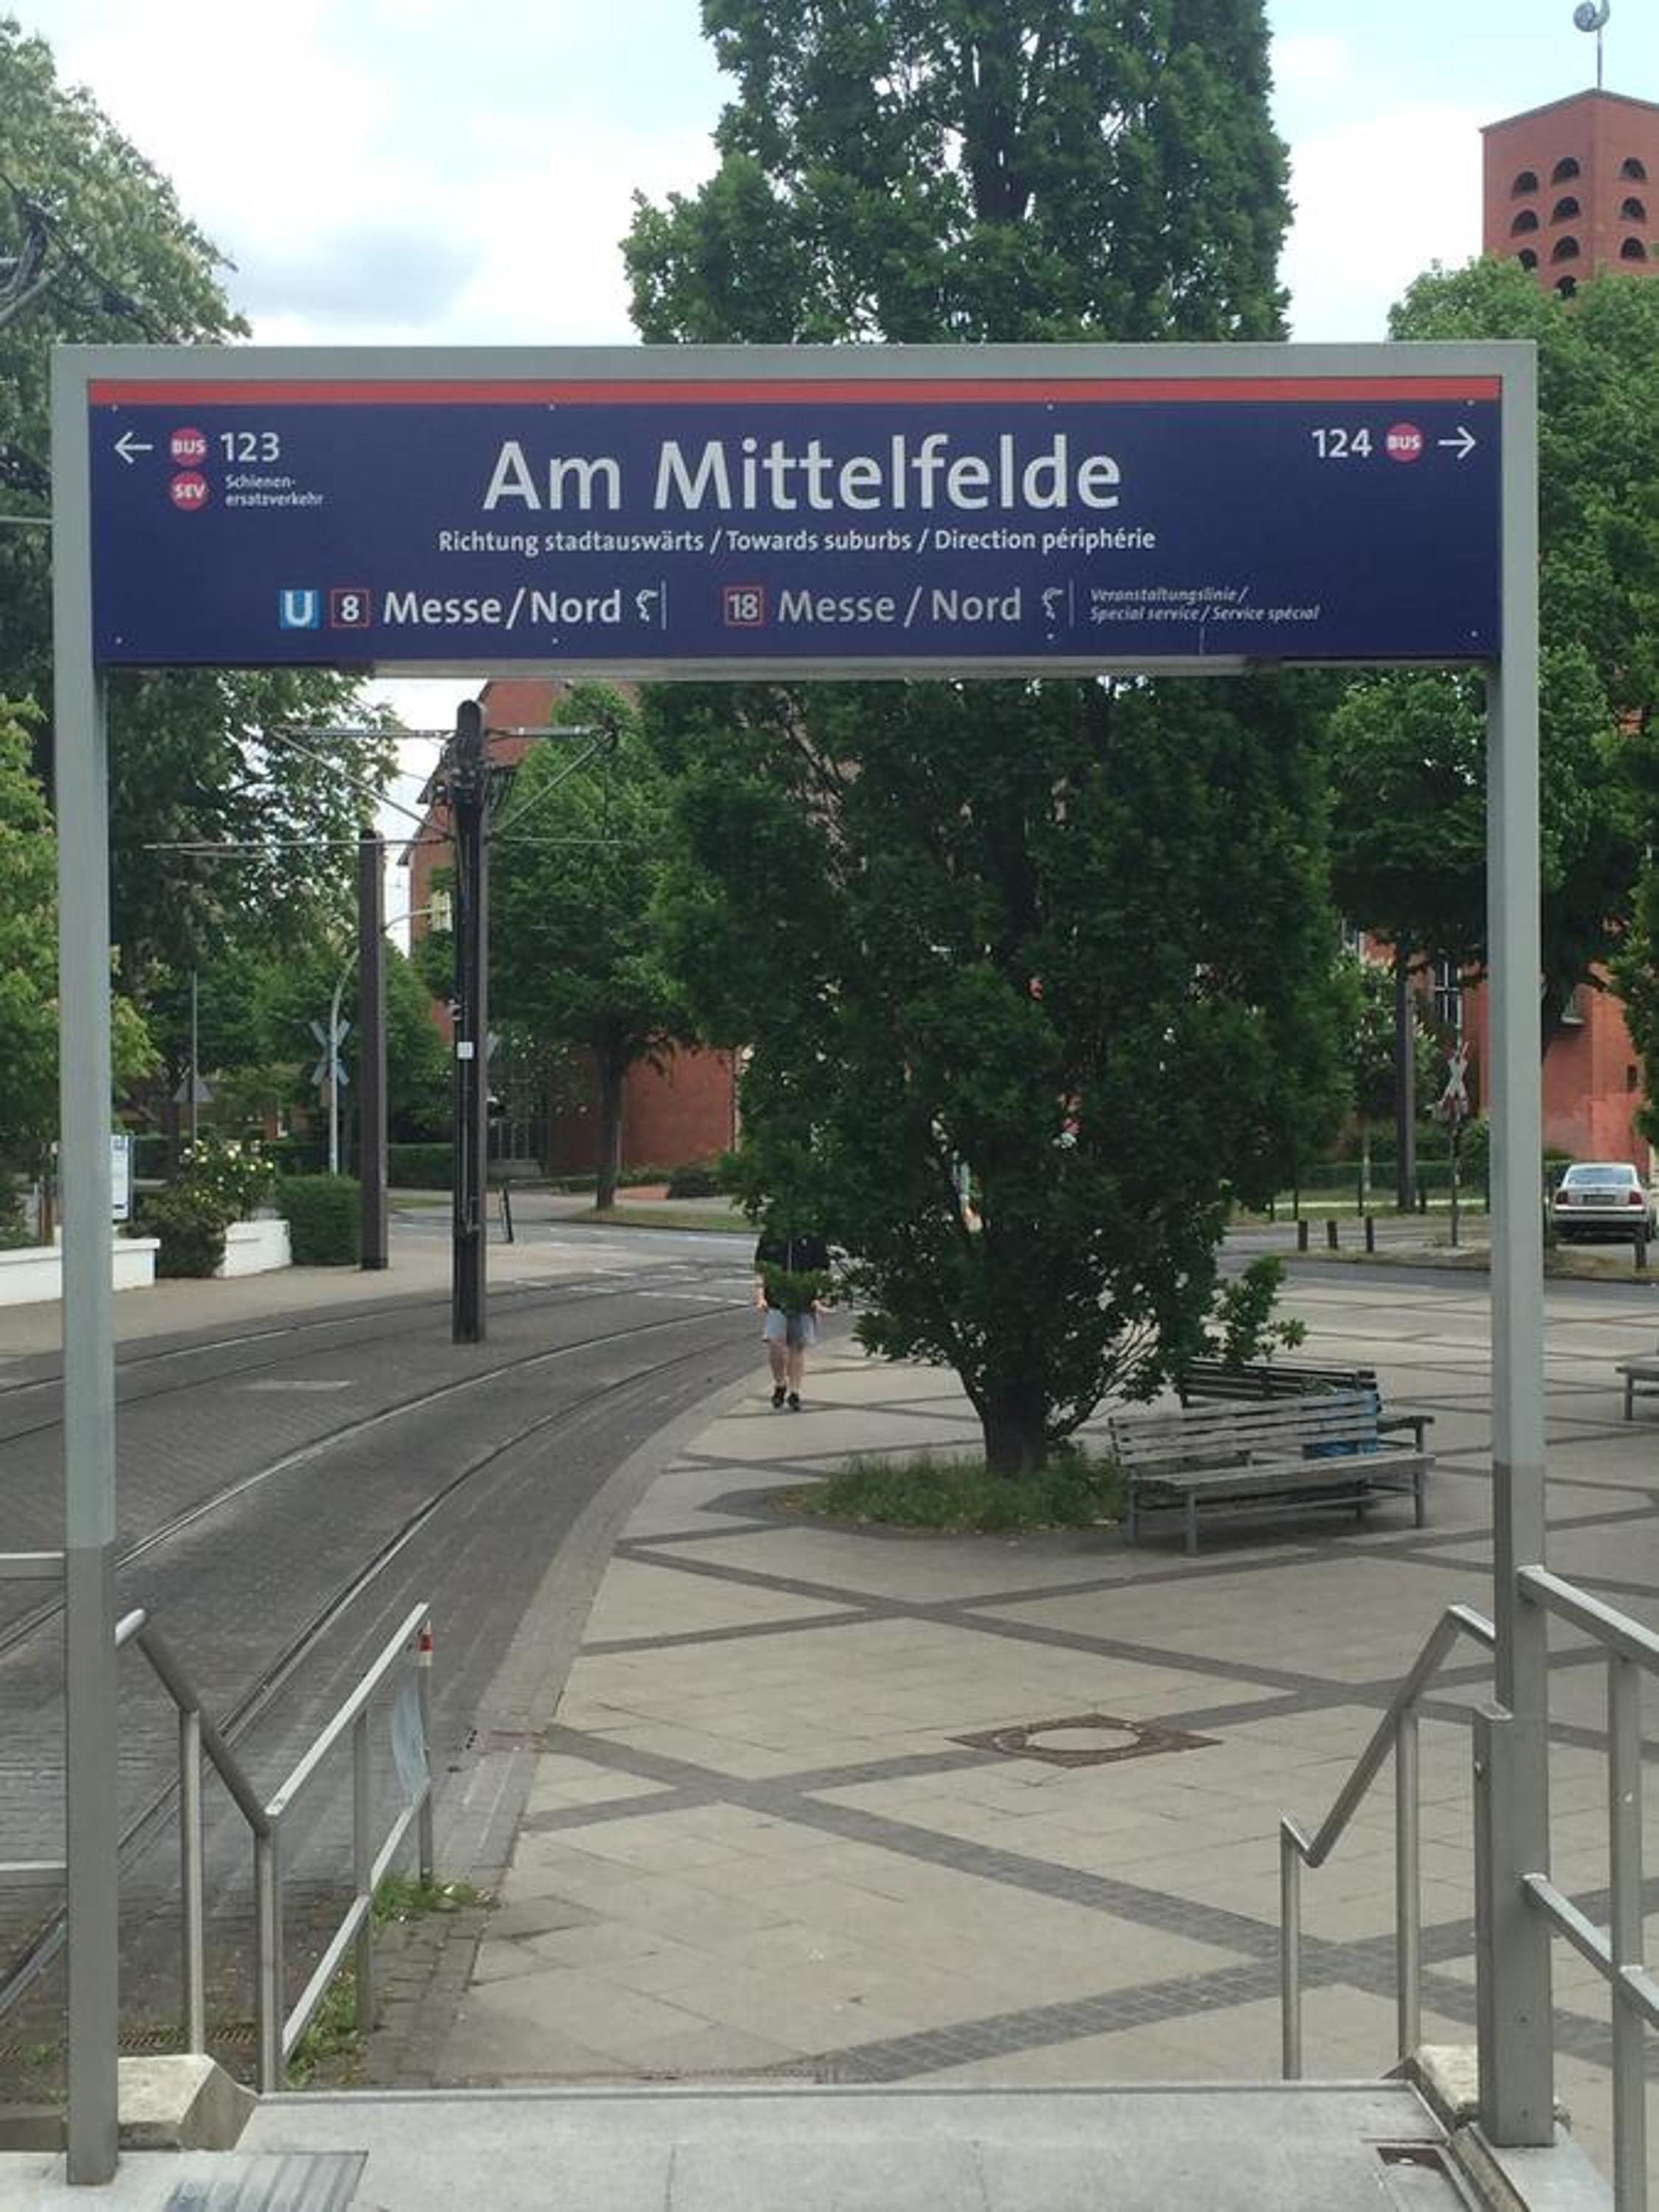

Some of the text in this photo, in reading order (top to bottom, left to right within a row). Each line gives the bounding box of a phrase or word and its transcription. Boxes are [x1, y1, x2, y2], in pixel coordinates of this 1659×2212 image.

[171, 431, 279, 462] BUS 123
[1312, 428, 1421, 458] 124 BUS
[225, 473, 296, 489] Schienen-
[483, 433, 1120, 510] Am Mittelfelde
[173, 483, 206, 499] SEV
[225, 491, 324, 507] ersatzverkehr
[439, 530, 539, 557] Richtung
[545, 530, 704, 552] stadtauswärts
[726, 529, 818, 551] Towards
[824, 529, 912, 551] suburbs
[935, 528, 1036, 549] Direction
[1042, 527, 1155, 555] périphérie
[285, 591, 313, 627] U
[341, 594, 360, 622] 8
[728, 594, 758, 620] 18
[1090, 605, 1146, 625] Special
